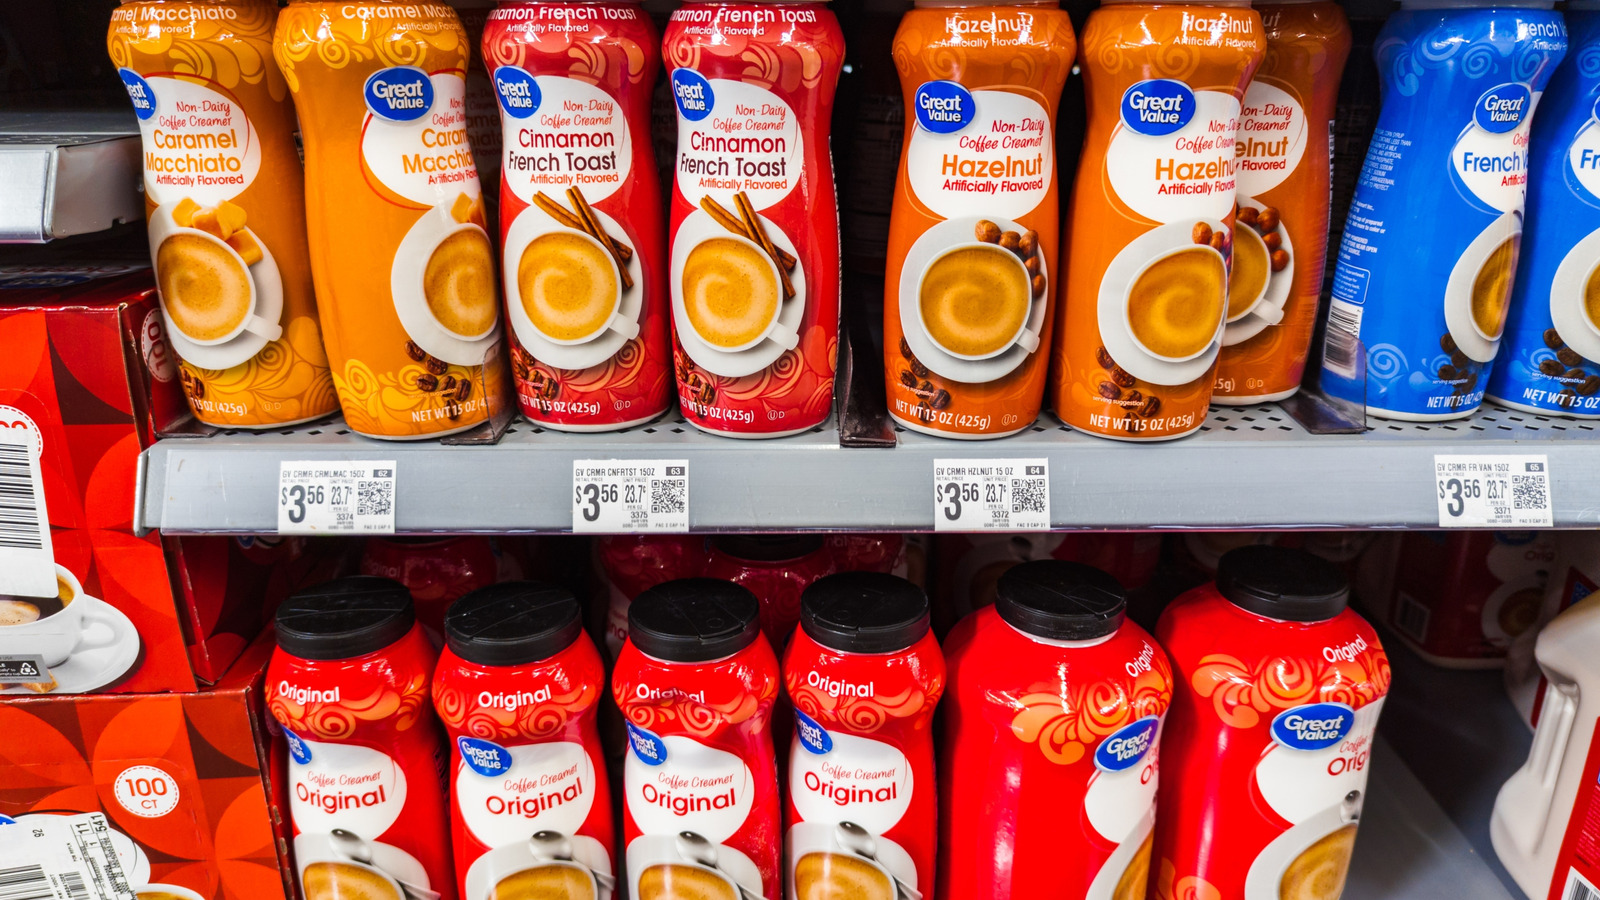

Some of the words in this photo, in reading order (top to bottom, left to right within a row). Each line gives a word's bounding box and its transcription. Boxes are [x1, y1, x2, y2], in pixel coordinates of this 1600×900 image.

[141, 6, 237, 20] Macchiato
[341, 5, 421, 20] Caramel
[540, 7, 597, 20] French
[601, 7, 636, 20] Toast
[718, 9, 775, 22] French
[779, 9, 816, 22] Toast
[548, 23, 589, 32] Flavored
[373, 80, 423, 98] Great
[497, 78, 531, 96] Great
[674, 79, 705, 99] Great
[176, 100, 231, 116] Non-Dairy
[386, 97, 424, 110] Value
[506, 95, 532, 108] Value
[563, 99, 613, 114] Non-Dairy
[682, 98, 705, 111] Value
[920, 92, 961, 112] Great
[1129, 91, 1183, 112] Great
[1484, 94, 1524, 112] Great
[432, 113, 455, 127] Coffee
[736, 103, 786, 120] Non-Dairy
[927, 109, 961, 122] Value
[1140, 109, 1179, 124] Value
[1490, 111, 1519, 122] Value
[159, 116, 186, 130] Coffee
[189, 117, 232, 127] Creamer
[541, 114, 570, 129] Coffee
[574, 115, 613, 126] Creamer
[713, 118, 742, 133] Coffee
[745, 118, 785, 131] Creamer
[991, 118, 1045, 135] Non-Dairy
[1245, 119, 1291, 131] Creamer
[154, 129, 237, 149] Caramel
[519, 128, 614, 148] Cinnamon
[691, 131, 785, 152] Cinnamon
[959, 135, 998, 152] Coffee
[1002, 135, 1043, 149] Creamer
[1175, 136, 1213, 153] Coffee
[146, 152, 241, 173] Macchiato
[509, 151, 560, 171] French
[565, 151, 616, 171] Toast
[680, 153, 728, 176] French
[735, 157, 786, 177] Toast
[942, 153, 1042, 178] Hazelnut
[1242, 159, 1286, 170] Flavored
[1463, 152, 1520, 173] French
[156, 175, 195, 188] Artificially
[198, 174, 244, 185] Flavored
[530, 174, 573, 186] Artificially
[577, 172, 618, 183] Flavored
[699, 178, 741, 191] Artificially
[745, 179, 787, 189] Flavored
[943, 179, 998, 195] Artificially
[1000, 178, 1043, 192] Flavored
[1158, 179, 1212, 196] Artificially
[1531, 372, 1552, 380] serving
[1554, 375, 1586, 384] suggestion
[204, 398, 214, 412] OZ
[215, 400, 248, 416] (425g)
[529, 396, 540, 408] WT
[553, 400, 565, 413] OZ
[567, 400, 601, 415] (425g)
[1113, 398, 1144, 408] suggestion
[1427, 396, 1442, 408] NET
[1443, 396, 1456, 407] WT
[1523, 388, 1544, 402] NET
[1547, 391, 1568, 406] WT
[1568, 395, 1583, 408] 15
[1585, 396, 1600, 409] OZ
[412, 409, 431, 423] NET
[435, 405, 450, 419] WT
[464, 401, 476, 413] OZ
[688, 400, 698, 413] WT
[709, 406, 721, 418] OZ
[723, 407, 755, 423] (425g)
[895, 399, 908, 414] NET
[909, 402, 923, 419] WT
[924, 408, 936, 423] 15
[939, 410, 952, 425] OZ
[955, 414, 991, 430] (425g)
[1090, 413, 1109, 427] NET
[1113, 418, 1132, 431] WT
[1134, 418, 1148, 432] 15
[1150, 417, 1164, 431] OZ
[1166, 411, 1194, 431] (425g)
[315, 470, 347, 478] CRMLMAC
[608, 468, 636, 476] CNFRTST
[968, 467, 993, 475] HZLNUT
[996, 467, 1002, 475] 15
[1005, 467, 1013, 475] OZ
[1323, 634, 1368, 663] Original
[1125, 640, 1154, 678] Original
[279, 680, 340, 705] Original
[807, 671, 874, 698] Original
[478, 684, 551, 711] Original
[1284, 715, 1344, 731] Great
[1107, 726, 1152, 754] Great
[1296, 729, 1338, 741] Value
[461, 741, 500, 760] Great
[1117, 742, 1147, 761] Value
[472, 755, 501, 769] Value
[822, 761, 851, 780] Coffee
[855, 768, 896, 780] Creamer
[308, 771, 336, 788] Coffee
[339, 771, 382, 786] Creamer
[504, 778, 537, 793] Coffee
[540, 763, 578, 785] Creamer
[658, 772, 688, 789] Coffee
[692, 773, 734, 788] Creamer
[125, 777, 168, 797] 100
[804, 771, 897, 806] Original
[141, 799, 158, 809] CT
[297, 782, 386, 814] Original
[486, 777, 583, 818] Original
[642, 783, 735, 816] Original
[90, 814, 108, 832] 541
[32, 828, 44, 838] 92
